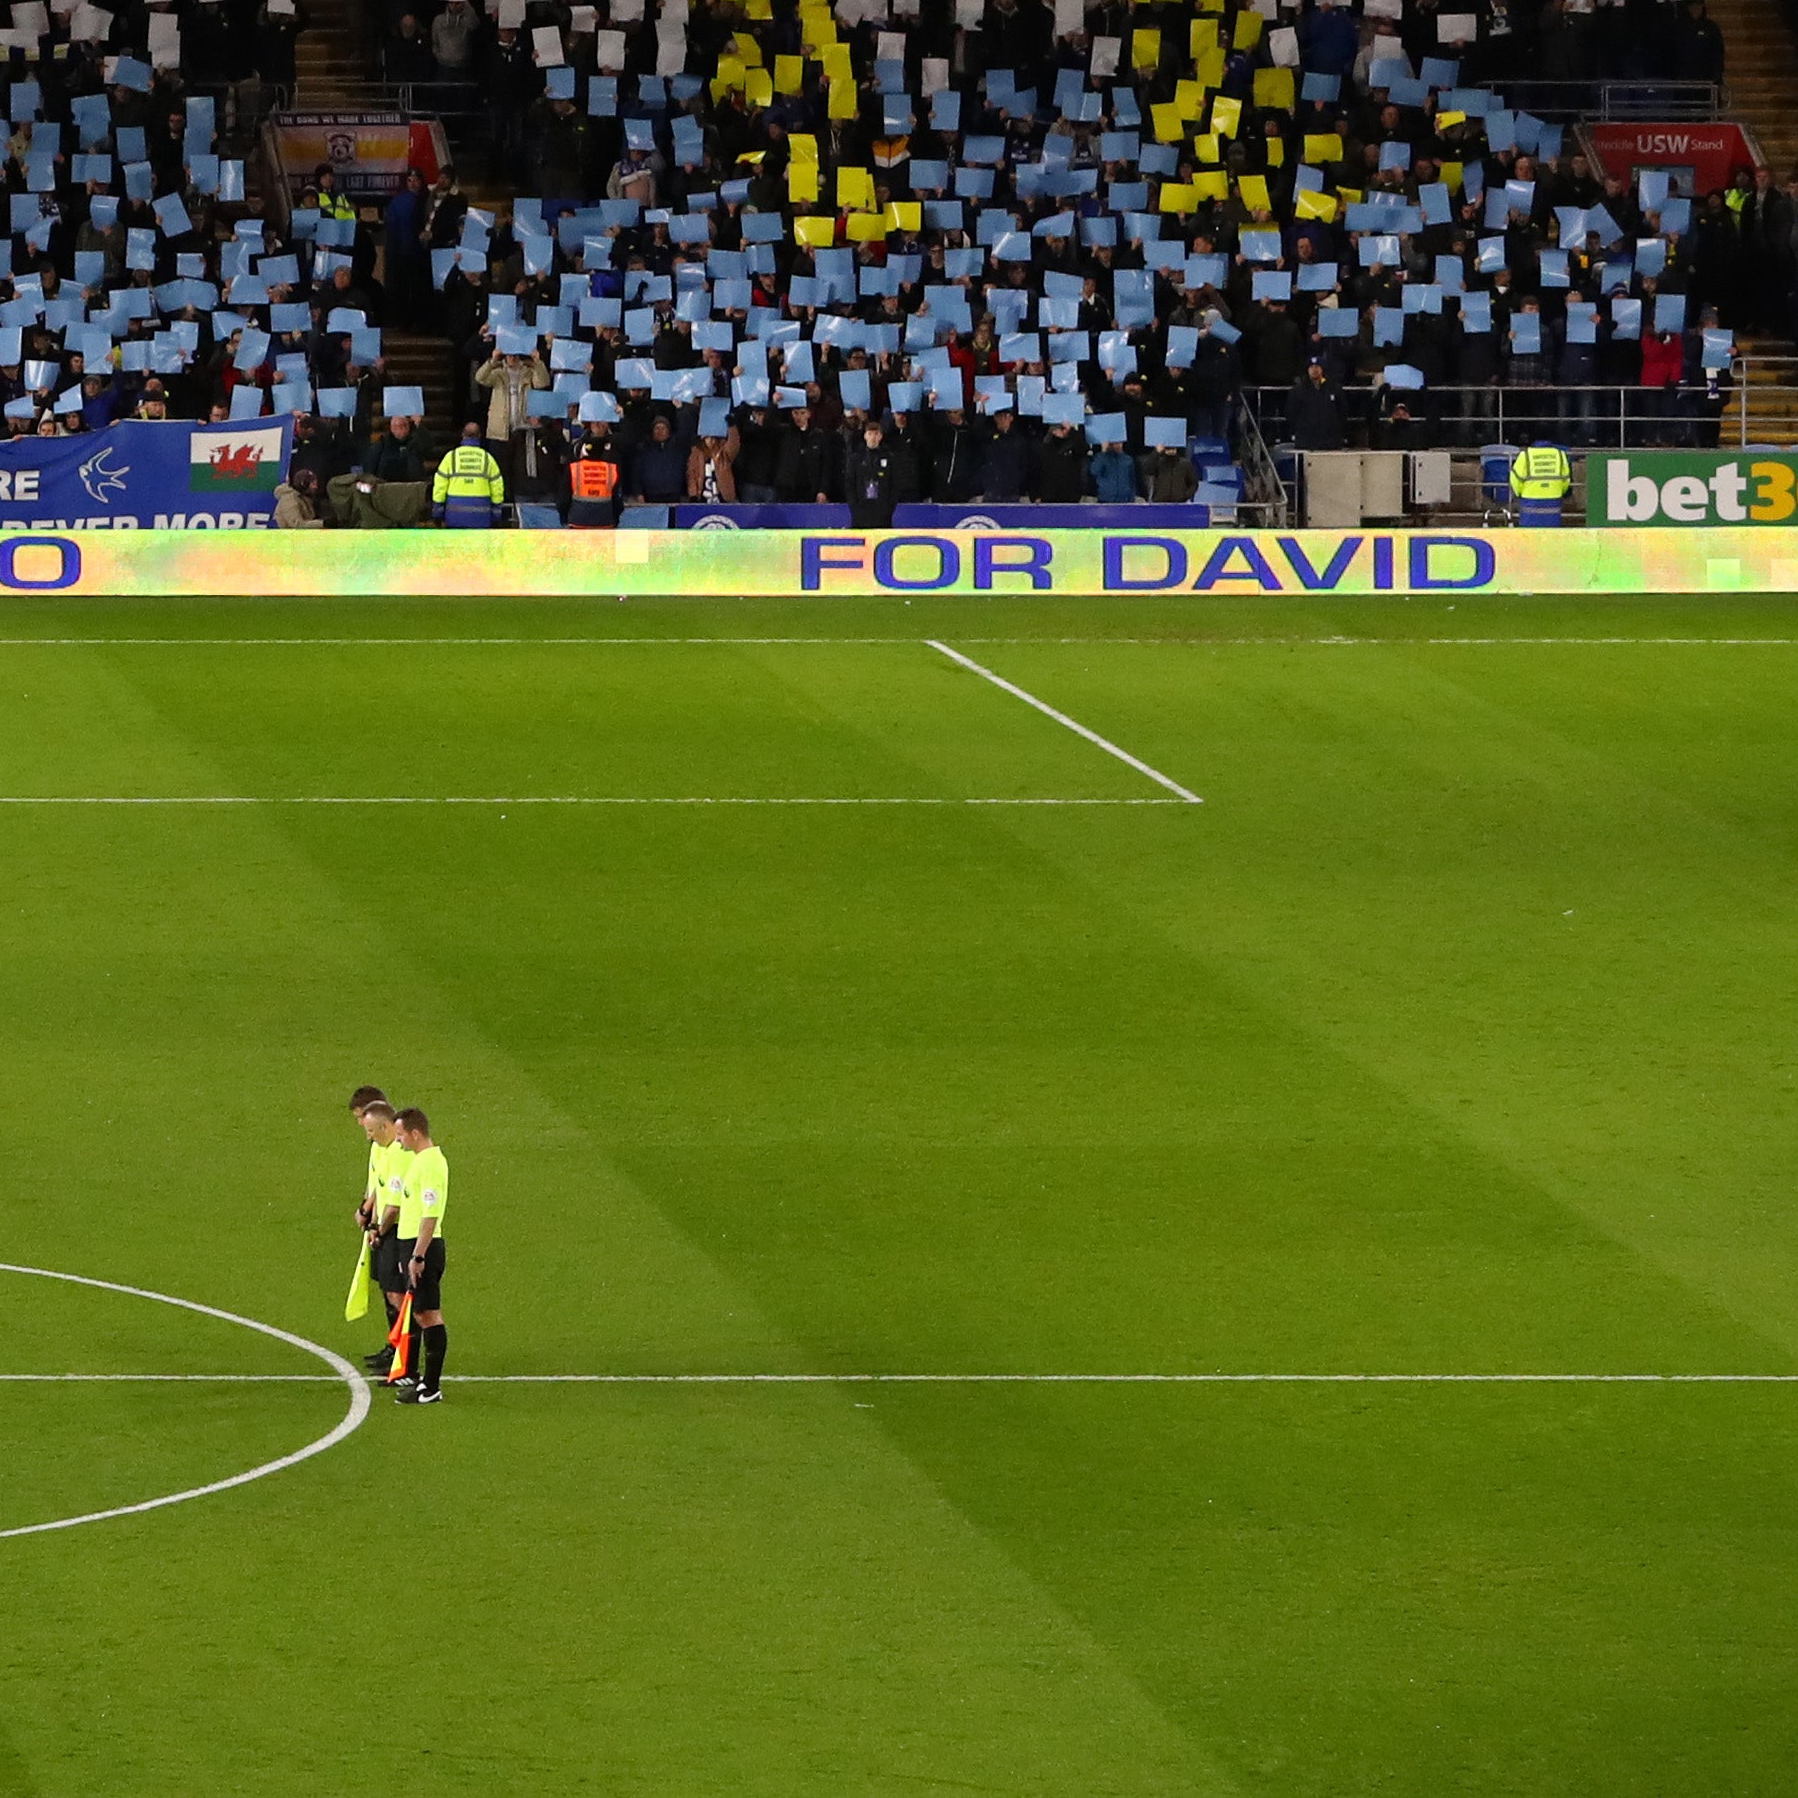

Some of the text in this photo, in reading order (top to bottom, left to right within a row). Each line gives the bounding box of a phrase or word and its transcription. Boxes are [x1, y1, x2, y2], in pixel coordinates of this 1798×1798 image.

[1636, 133, 1690, 154] USW
[802, 536, 1494, 591] FOR DAVID
